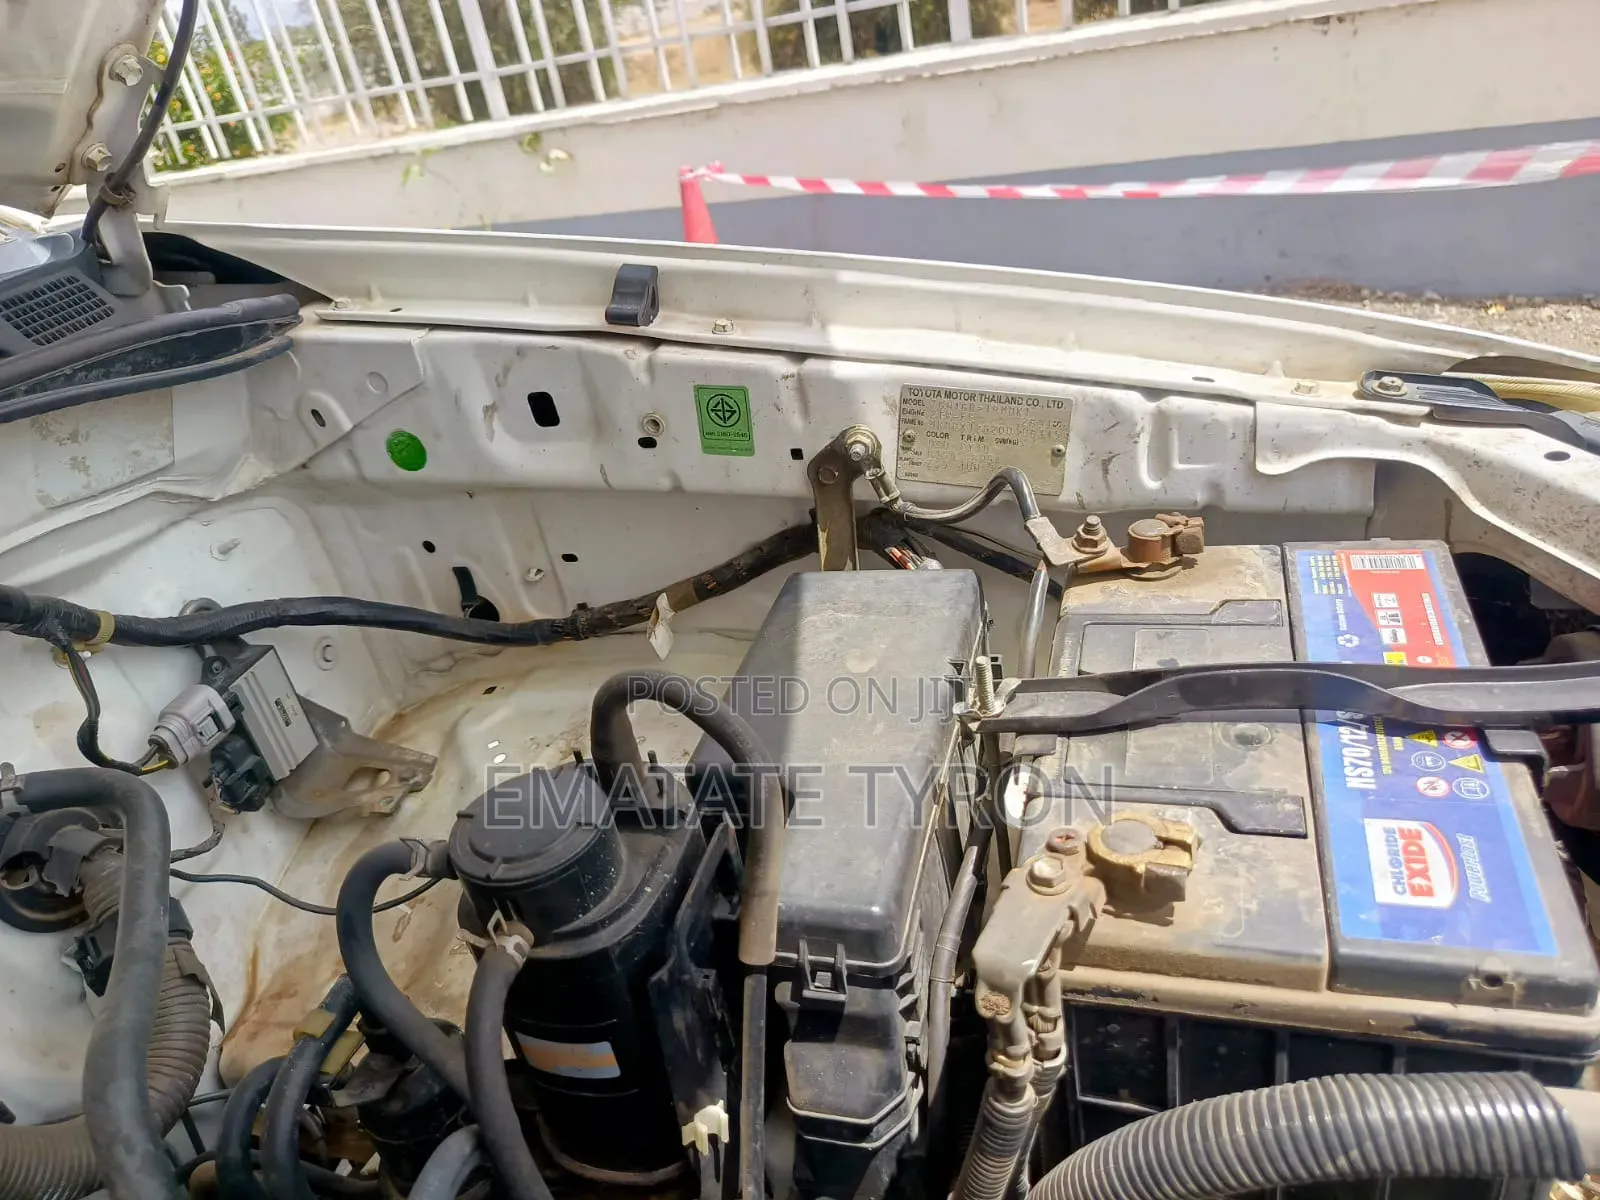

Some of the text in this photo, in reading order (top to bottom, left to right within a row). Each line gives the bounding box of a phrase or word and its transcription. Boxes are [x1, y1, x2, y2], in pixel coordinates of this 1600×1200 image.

[902, 398, 926, 407] MODEL
[907, 387, 942, 399] TOYOTA
[944, 390, 976, 402] MOTOR
[979, 393, 1023, 406] THAILAND
[926, 430, 950, 440] COLOR
[1383, 826, 1407, 896] CHLORIDE
[1398, 826, 1435, 897] EXIDE
